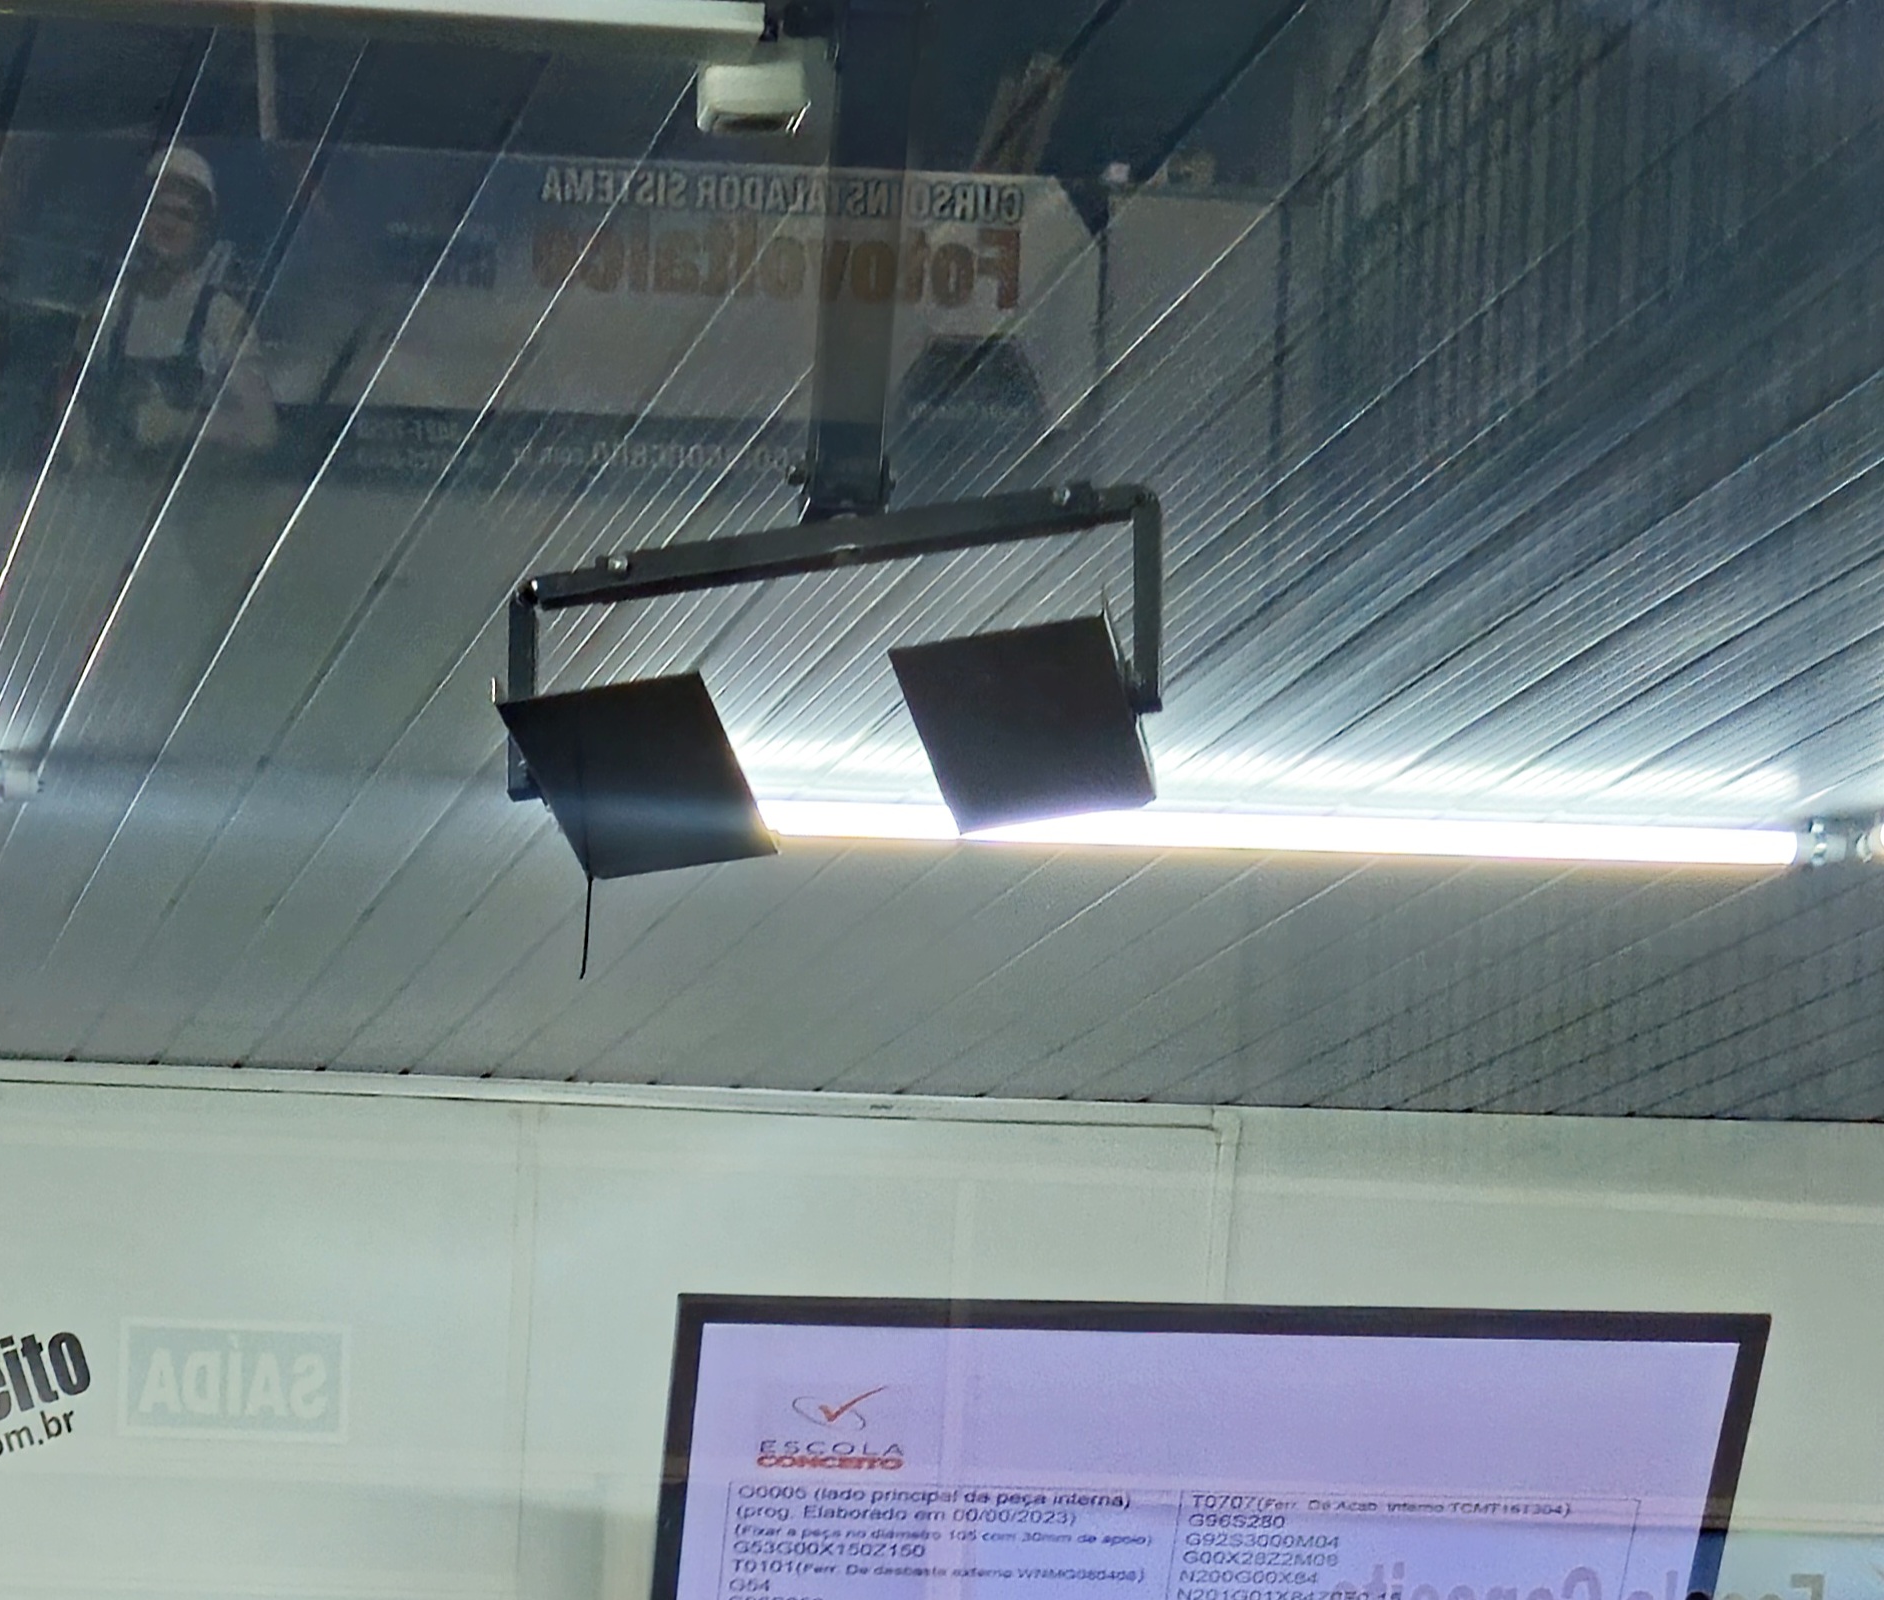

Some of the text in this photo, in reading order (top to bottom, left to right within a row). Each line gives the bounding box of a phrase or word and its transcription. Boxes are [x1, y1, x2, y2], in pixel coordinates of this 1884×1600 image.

[758, 1439, 904, 1456] ESCOLA
[871, 1487, 957, 1505] principal
[964, 1491, 992, 1505] da
[1052, 1491, 1132, 1509] interna)
[803, 1505, 907, 1521] Elaborado
[914, 1509, 946, 1522] em
[952, 1508, 1077, 1526] 00/00/2023)
[1185, 1533, 1340, 1549] G92S3000M04
[729, 1579, 771, 1592] G54
